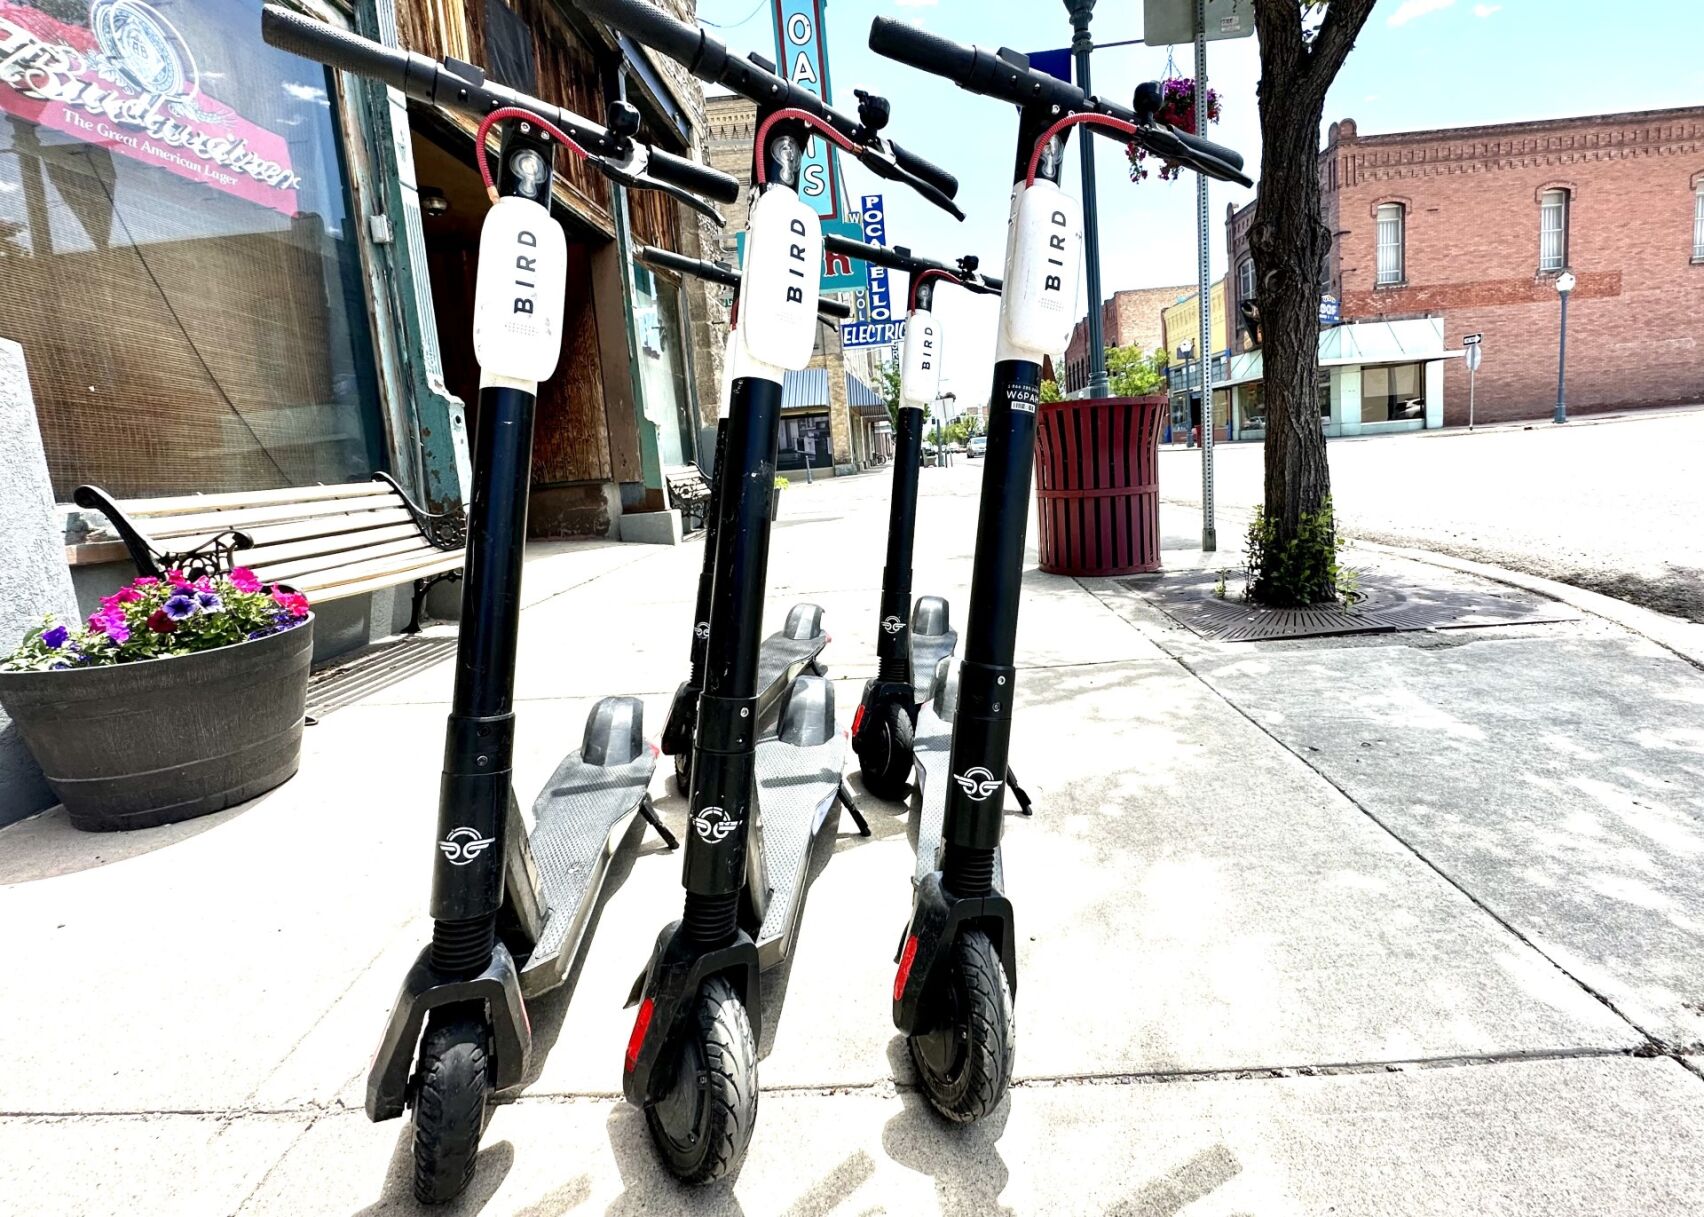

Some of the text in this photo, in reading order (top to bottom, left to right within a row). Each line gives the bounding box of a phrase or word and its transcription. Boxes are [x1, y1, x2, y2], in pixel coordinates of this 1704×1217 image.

[787, 13, 825, 196] OAIS
[63, 108, 239, 186] The Great American Lager
[513, 230, 536, 314] BIRD
[786, 218, 805, 304] BIRD
[863, 196, 890, 320] POCELLO
[1044, 210, 1066, 291] BIRD
[921, 327, 933, 370] BIRD
